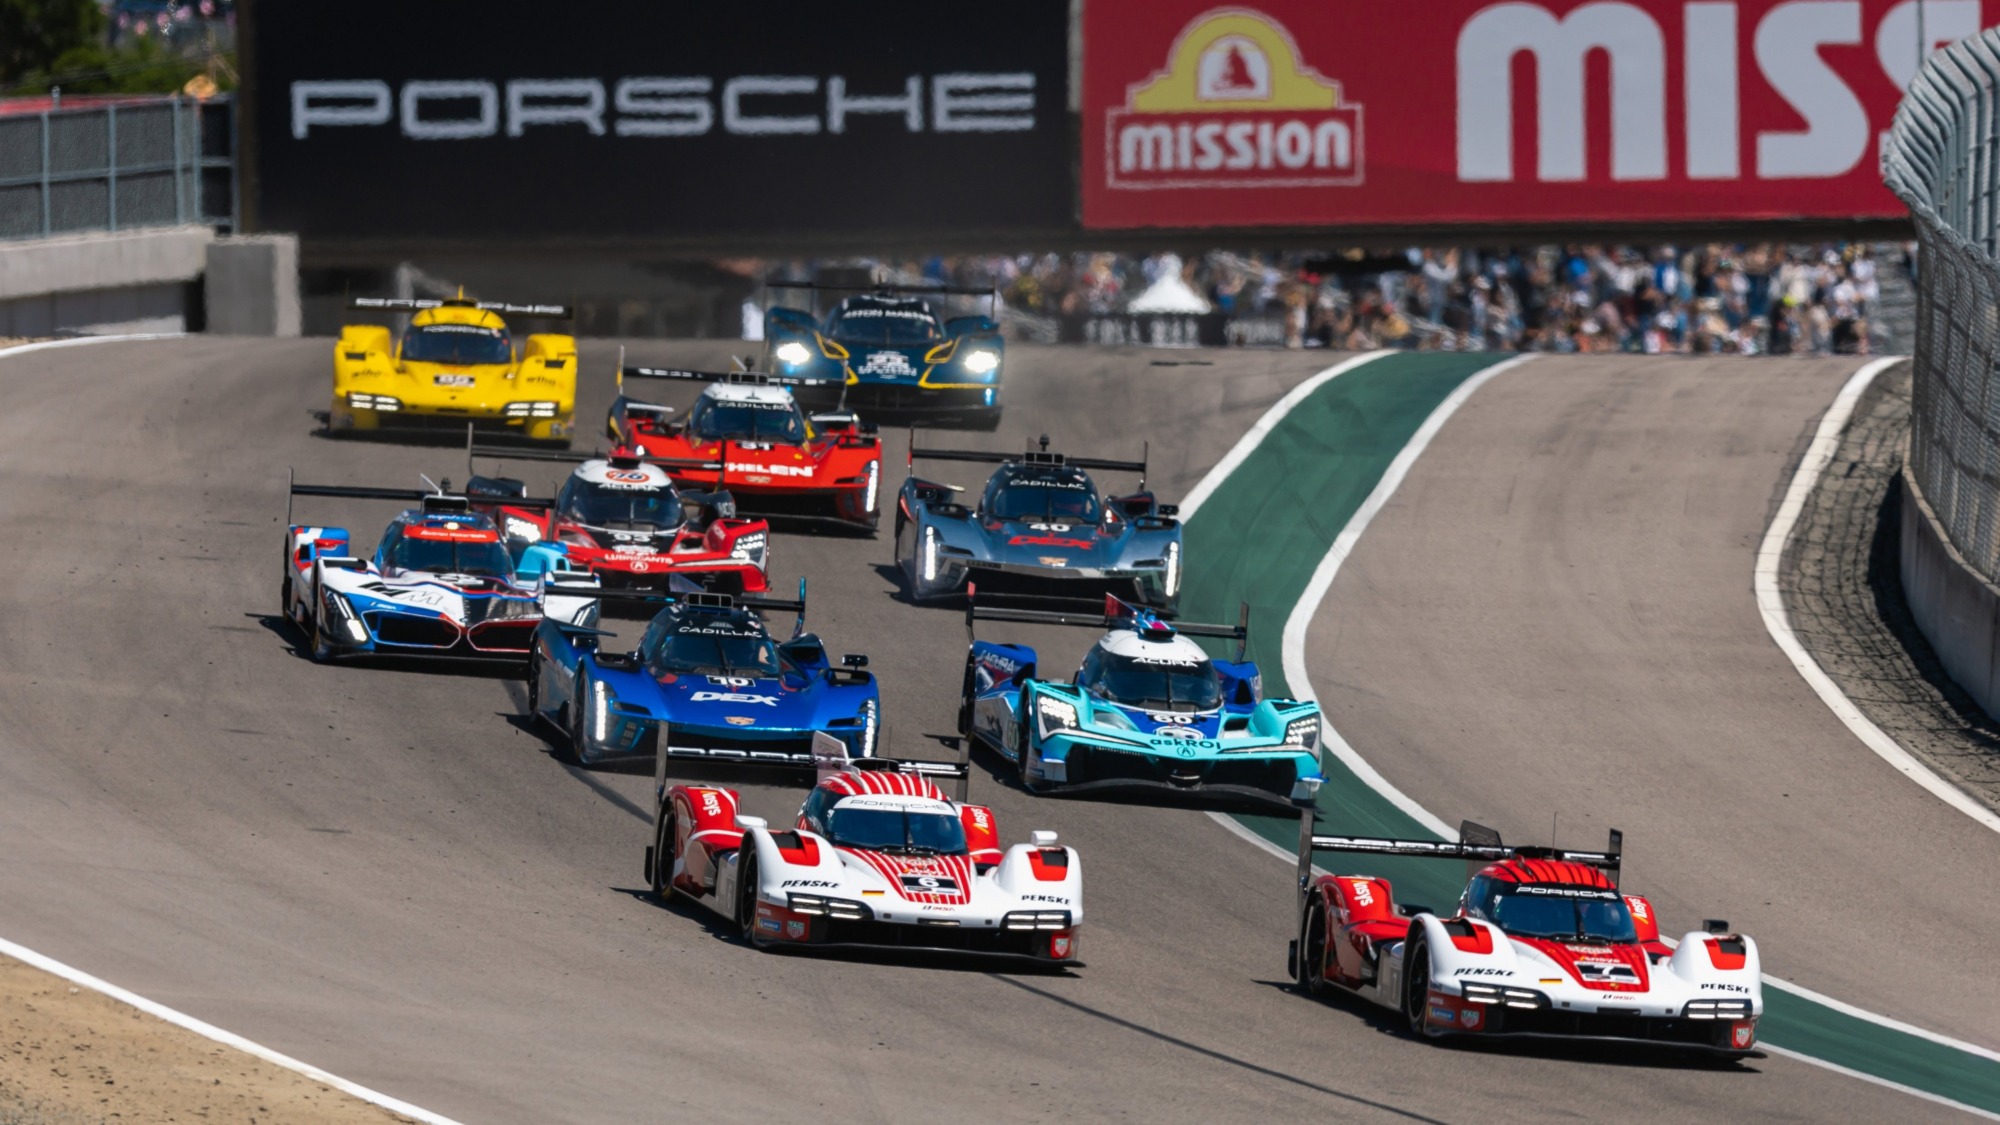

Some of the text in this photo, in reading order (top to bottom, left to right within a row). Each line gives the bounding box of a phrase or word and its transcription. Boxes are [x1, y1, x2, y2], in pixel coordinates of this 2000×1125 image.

[291, 73, 1036, 140] PORSCHE
[1119, 119, 1351, 173] MISSION
[724, 462, 813, 477] HELEN
[598, 482, 660, 491] ACURA
[1009, 479, 1086, 490] CADILLAC
[1029, 523, 1071, 532] 40
[678, 626, 763, 638] CADILLAC
[1132, 657, 1199, 668] ACURA
[712, 676, 750, 686] 10
[689, 691, 781, 707] DEX
[1153, 714, 1193, 725] 60
[1149, 738, 1222, 750] askROI
[700, 789, 722, 817] Ansys
[849, 799, 948, 811] PORSCHE
[781, 880, 840, 889] PENSKE
[918, 877, 940, 888] 6
[1350, 879, 1374, 907] Ansys
[1516, 886, 1619, 900] PORSCHE
[1021, 894, 1071, 906] PENSKE
[1454, 967, 1516, 977] PENSKE
[1594, 964, 1615, 976] 7
[1700, 983, 1751, 994] PENSKE
